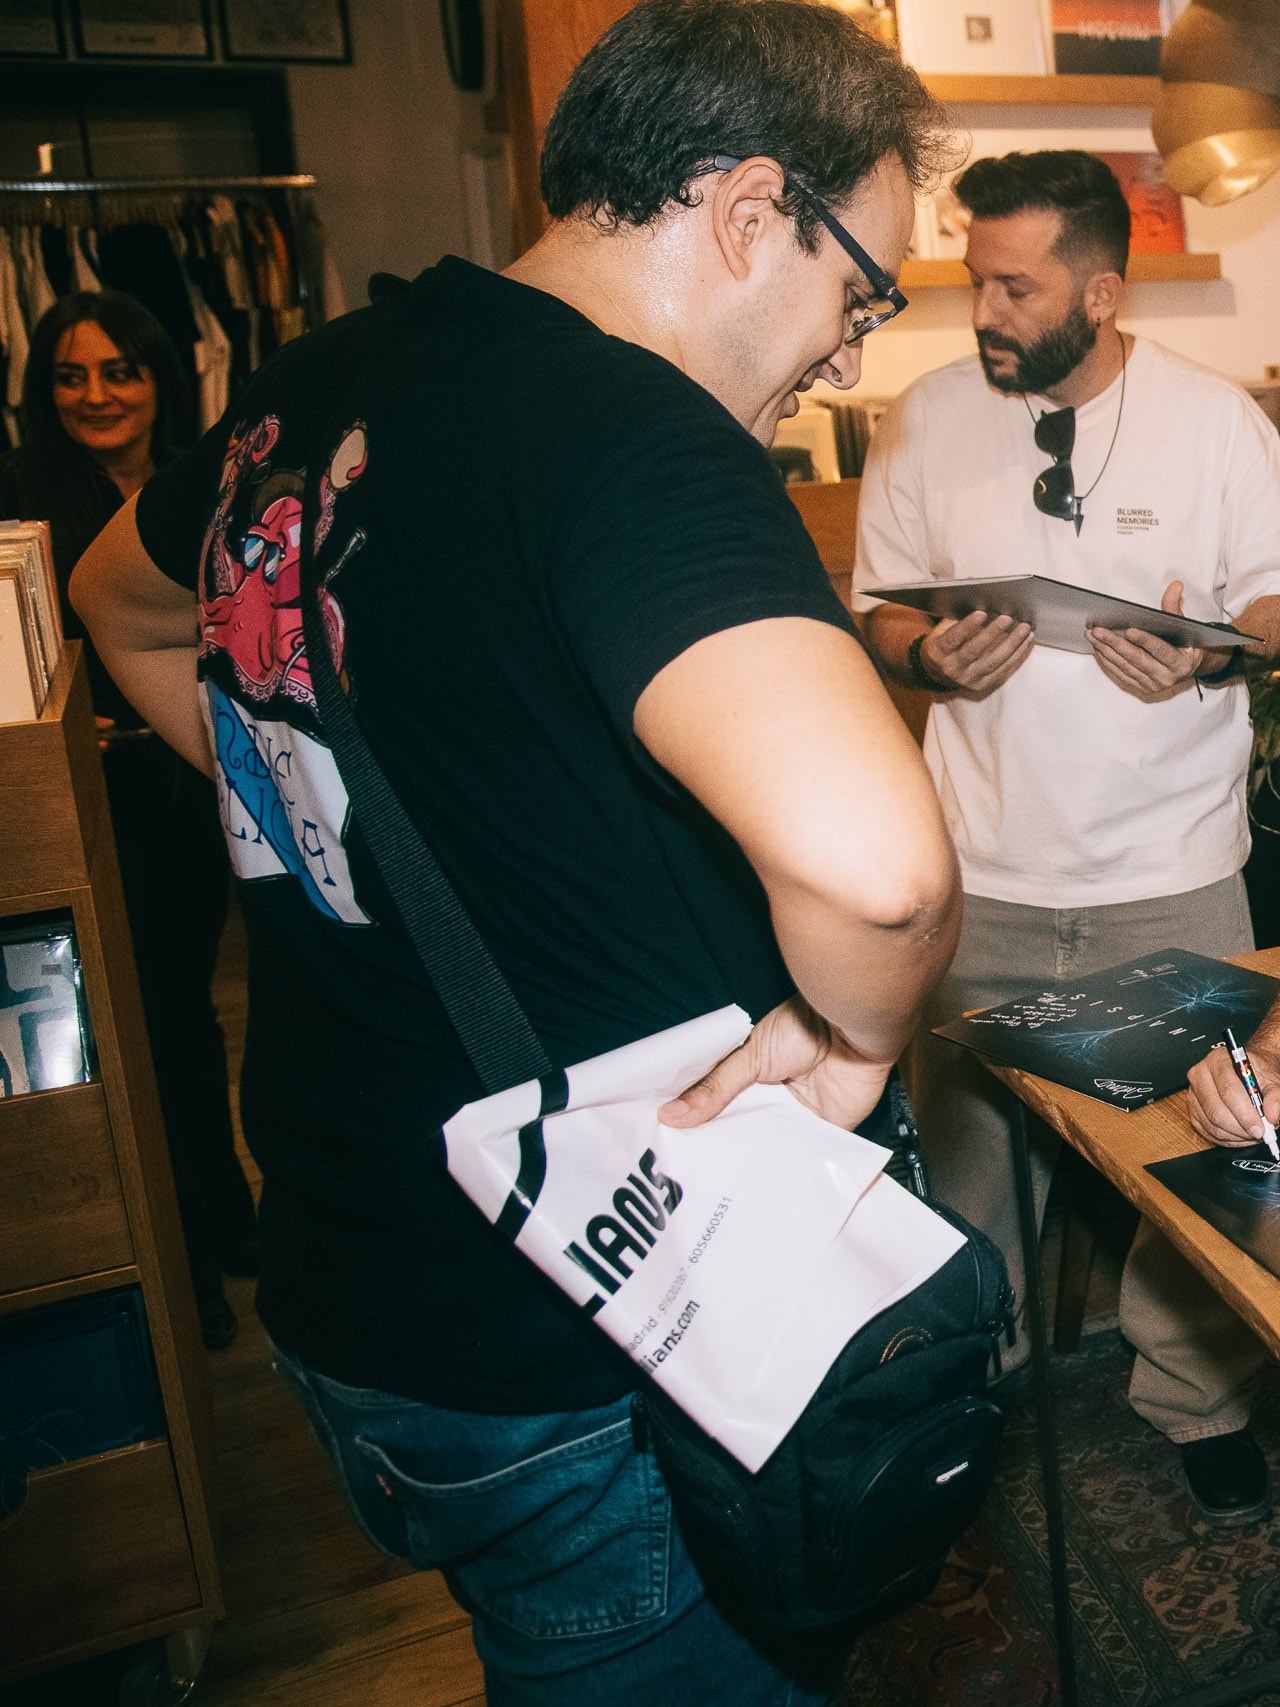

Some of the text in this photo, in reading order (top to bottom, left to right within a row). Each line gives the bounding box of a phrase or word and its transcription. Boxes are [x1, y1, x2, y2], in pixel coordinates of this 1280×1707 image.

[1117, 508, 1153, 517] BLURRED
[1117, 517, 1159, 526] MEMORIES
[690, 1197, 733, 1265] 605660531
[639, 1299, 700, 1374] lians.com
